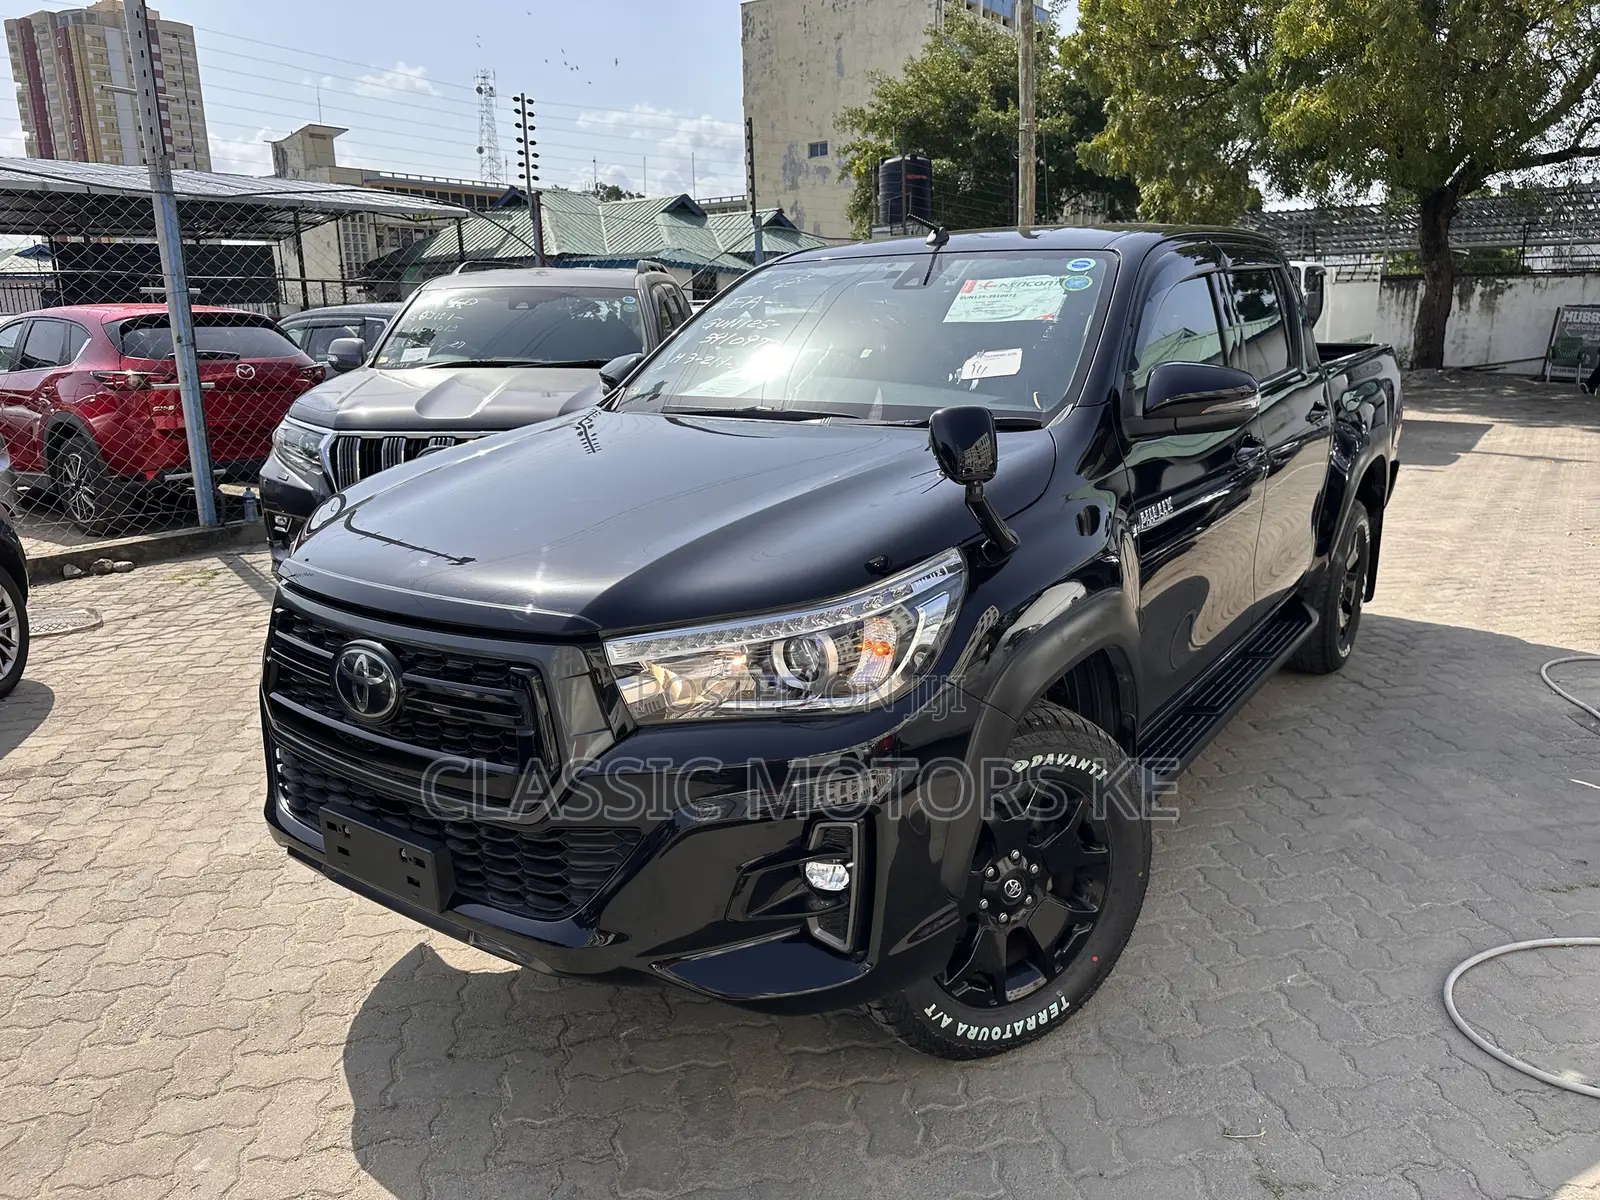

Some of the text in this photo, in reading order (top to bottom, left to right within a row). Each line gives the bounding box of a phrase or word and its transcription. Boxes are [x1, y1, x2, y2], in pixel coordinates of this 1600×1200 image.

[1031, 753, 1108, 780] DAVANTI
[923, 995, 1070, 1042] TERRATOURA A/T
